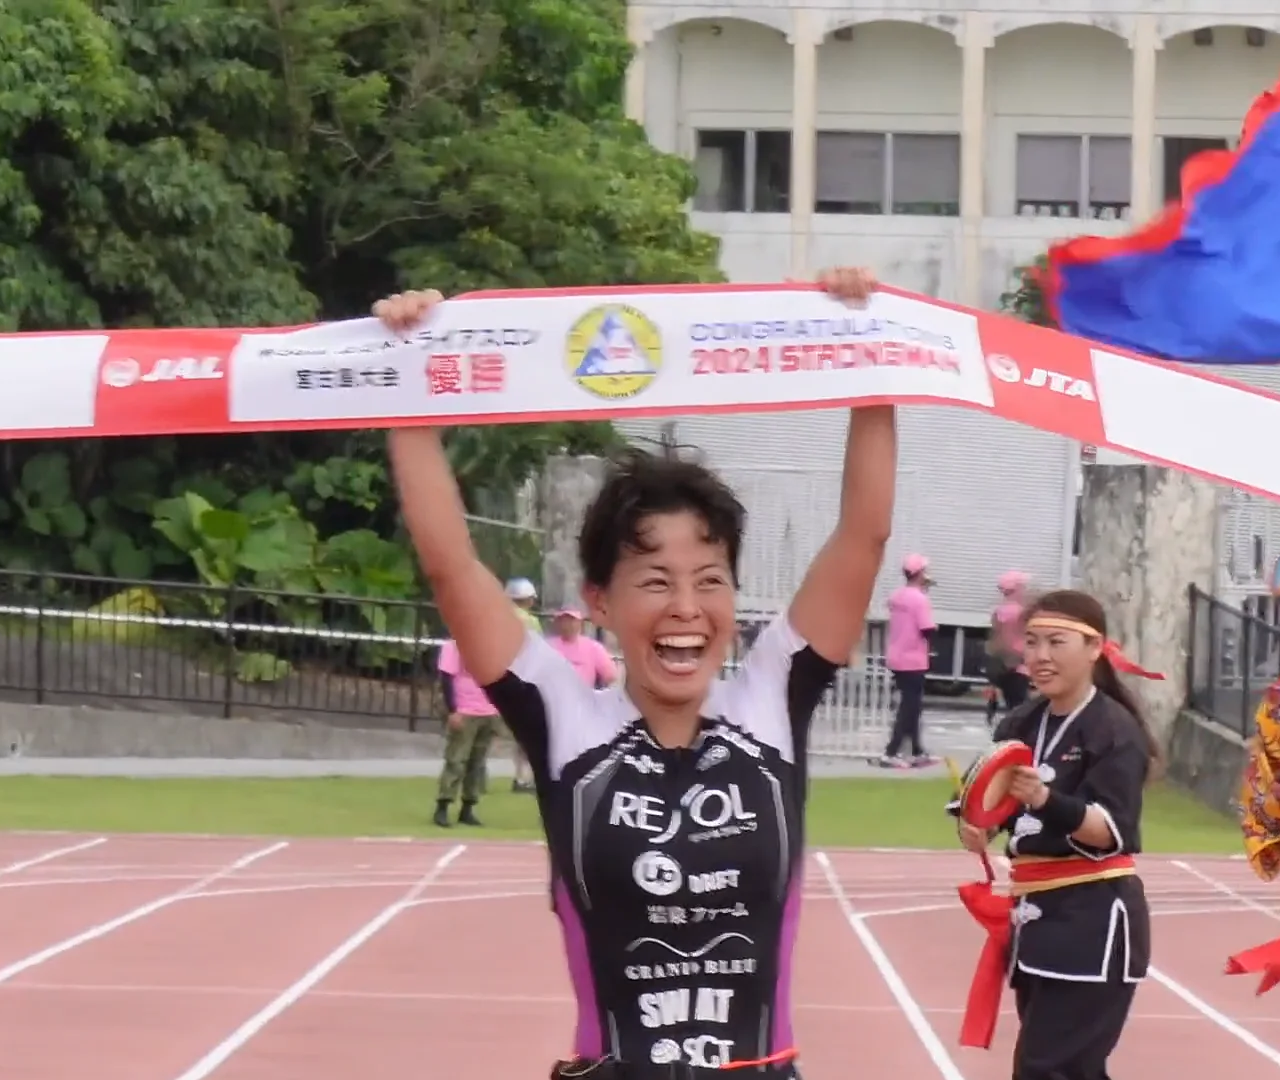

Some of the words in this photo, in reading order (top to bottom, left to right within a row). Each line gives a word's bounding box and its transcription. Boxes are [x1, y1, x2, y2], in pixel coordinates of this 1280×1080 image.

[141, 356, 224, 381] JAL
[692, 347, 771, 375] 2024
[1023, 367, 1097, 401] JTA
